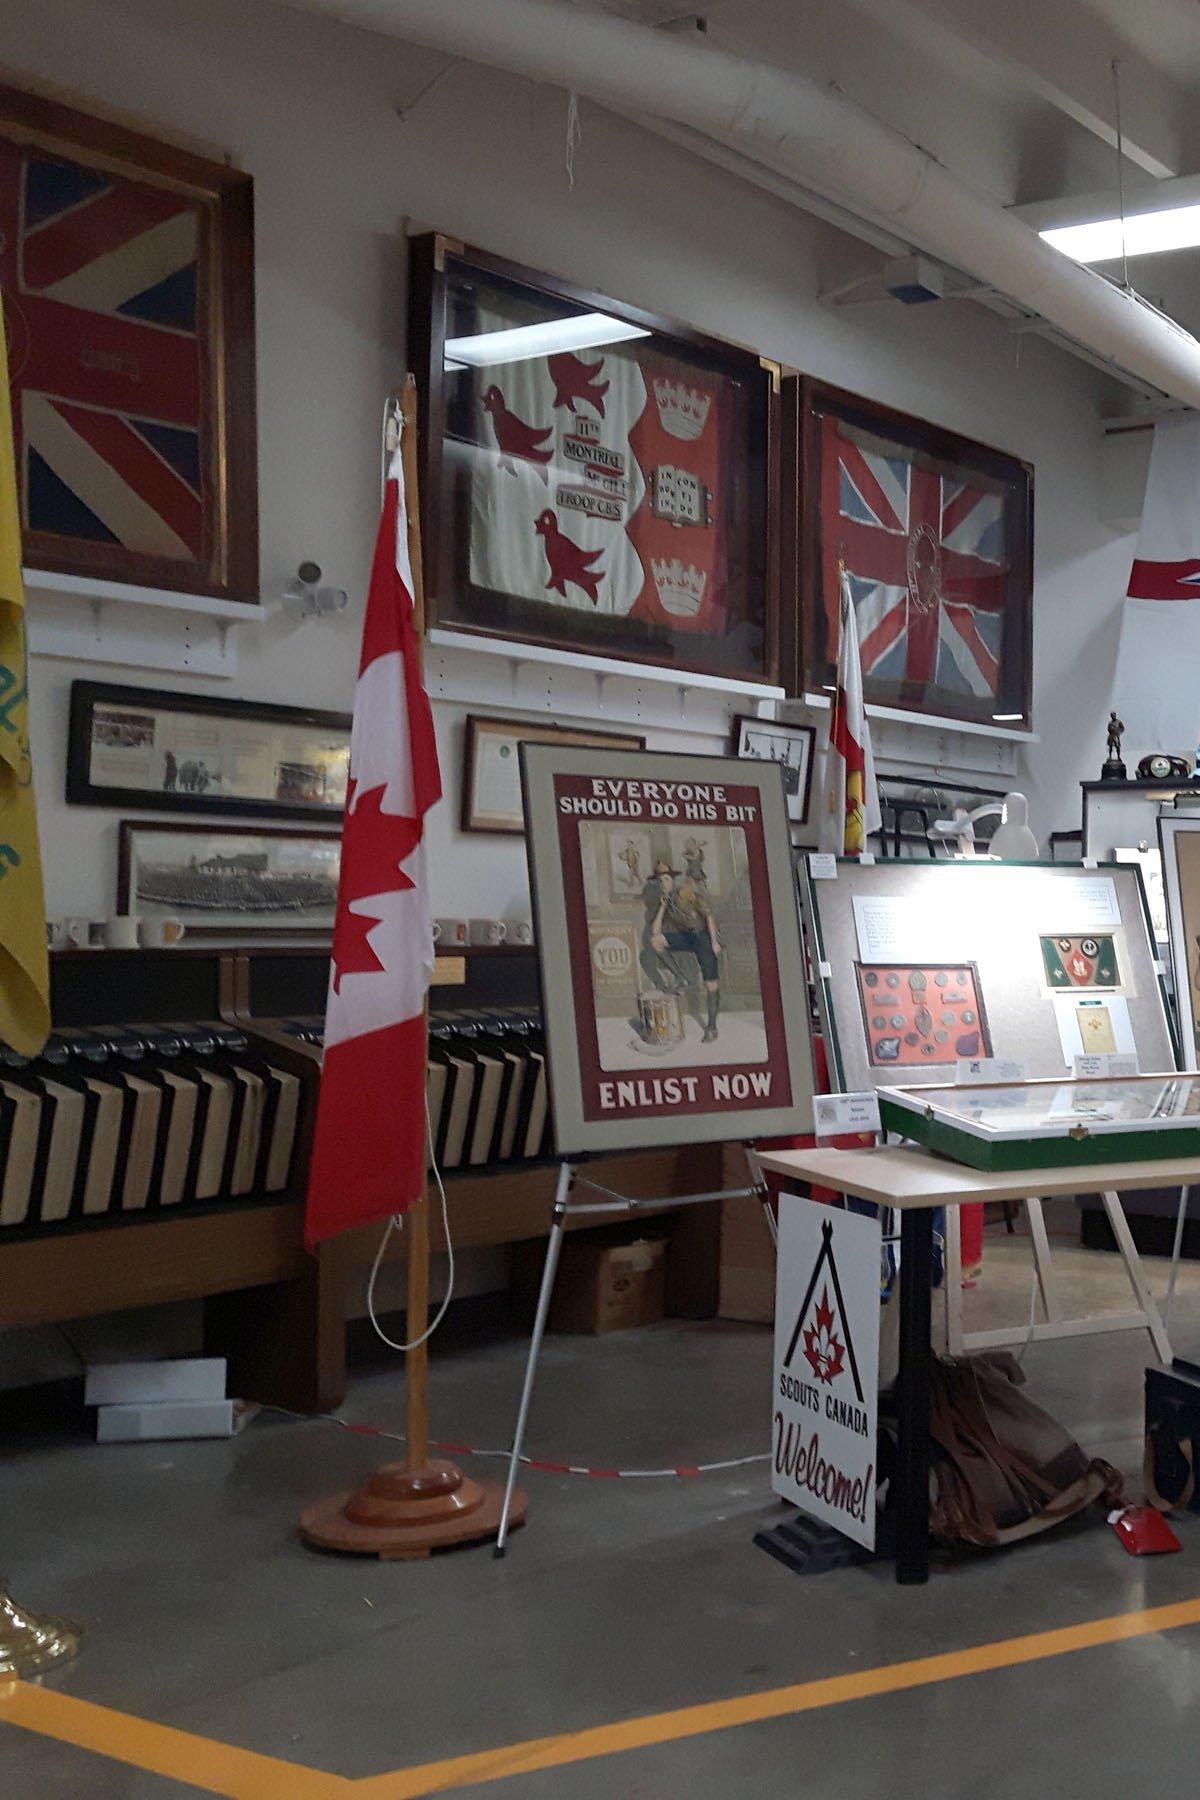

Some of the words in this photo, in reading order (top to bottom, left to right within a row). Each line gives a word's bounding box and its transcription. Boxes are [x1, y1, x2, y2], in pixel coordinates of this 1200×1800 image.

[592, 779, 727, 803] EVERYONE
[559, 796, 642, 818] SHOULD
[651, 801, 680, 818] DO
[685, 803, 717, 821] HIS
[726, 805, 757, 824] BIT
[597, 947, 629, 965] YOU
[598, 1076, 700, 1110] ENLIST
[712, 1071, 772, 1101] NOW
[779, 1374, 819, 1412] SCOUTS
[825, 1395, 868, 1437] CANADA
[774, 1413, 873, 1523] Welcome!
